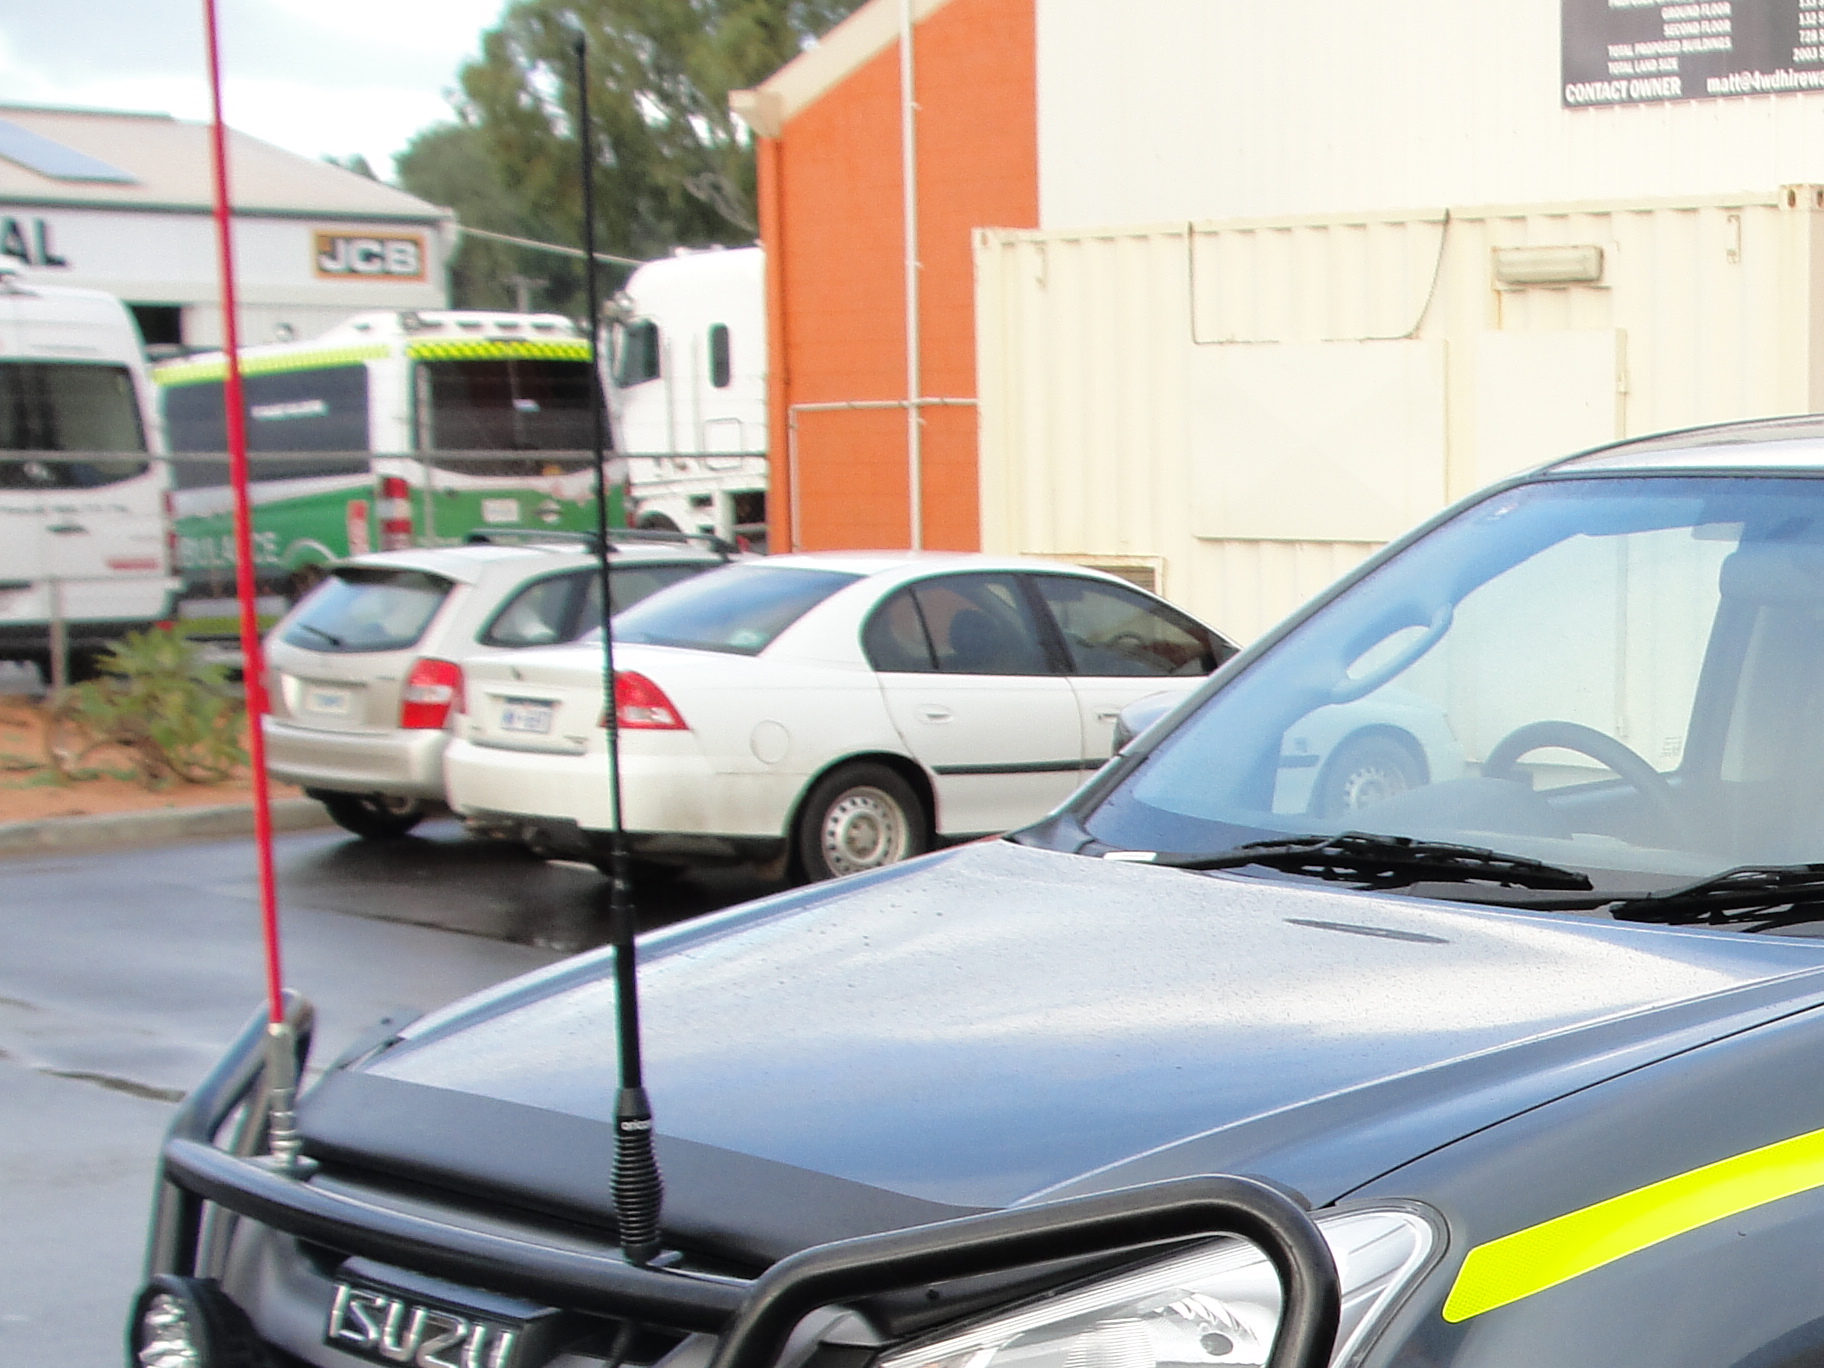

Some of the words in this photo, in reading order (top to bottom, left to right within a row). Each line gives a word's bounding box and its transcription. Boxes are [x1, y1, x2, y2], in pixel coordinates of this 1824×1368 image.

[1565, 80, 1629, 105] CONTACT
[1629, 76, 1683, 101] OWNER
[319, 238, 418, 275] JCB
